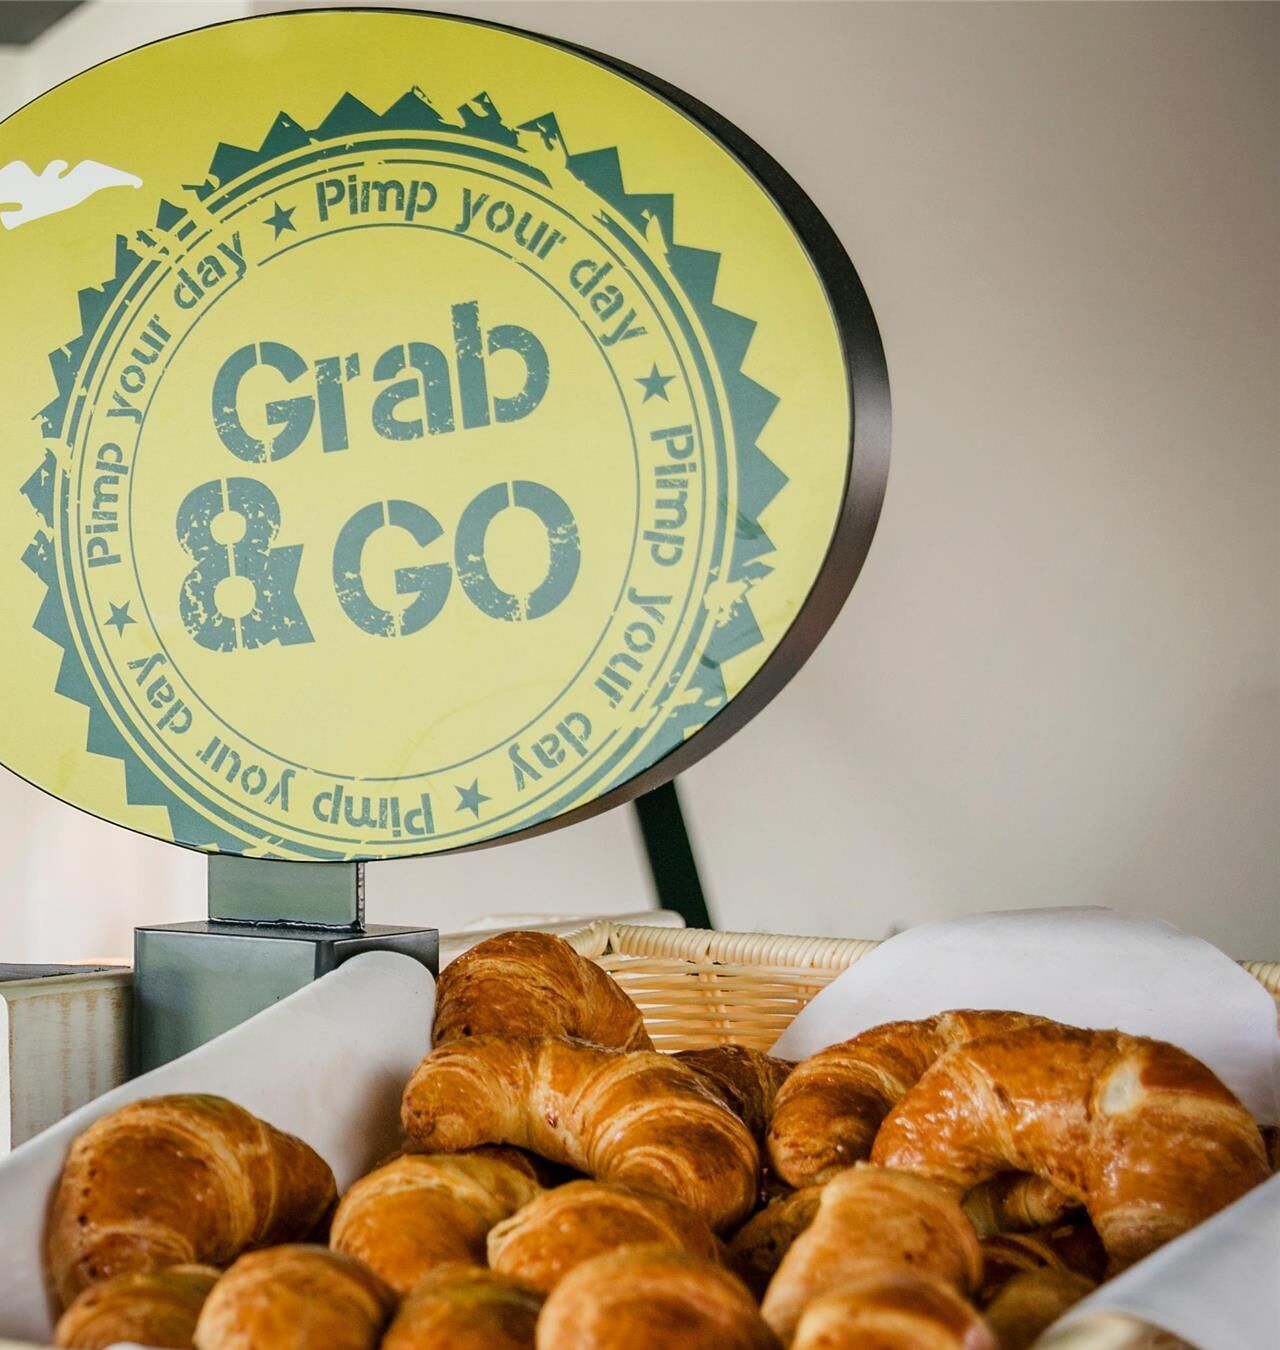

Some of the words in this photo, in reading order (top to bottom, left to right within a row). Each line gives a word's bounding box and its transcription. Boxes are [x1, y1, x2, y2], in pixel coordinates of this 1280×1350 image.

[173, 234, 247, 310] day
[316, 175, 437, 223] Pimp
[456, 187, 565, 261] your
[570, 259, 646, 350] day
[106, 315, 172, 426] your
[210, 301, 551, 465] Grab
[85, 442, 130, 569] Pimp
[649, 424, 698, 567] Pimp
[175, 476, 316, 653] &
[331, 479, 582, 639] GO
[127, 652, 193, 735] day
[594, 586, 669, 711] your
[195, 735, 298, 813] your
[507, 711, 593, 791] day
[312, 784, 437, 838] Pimp
